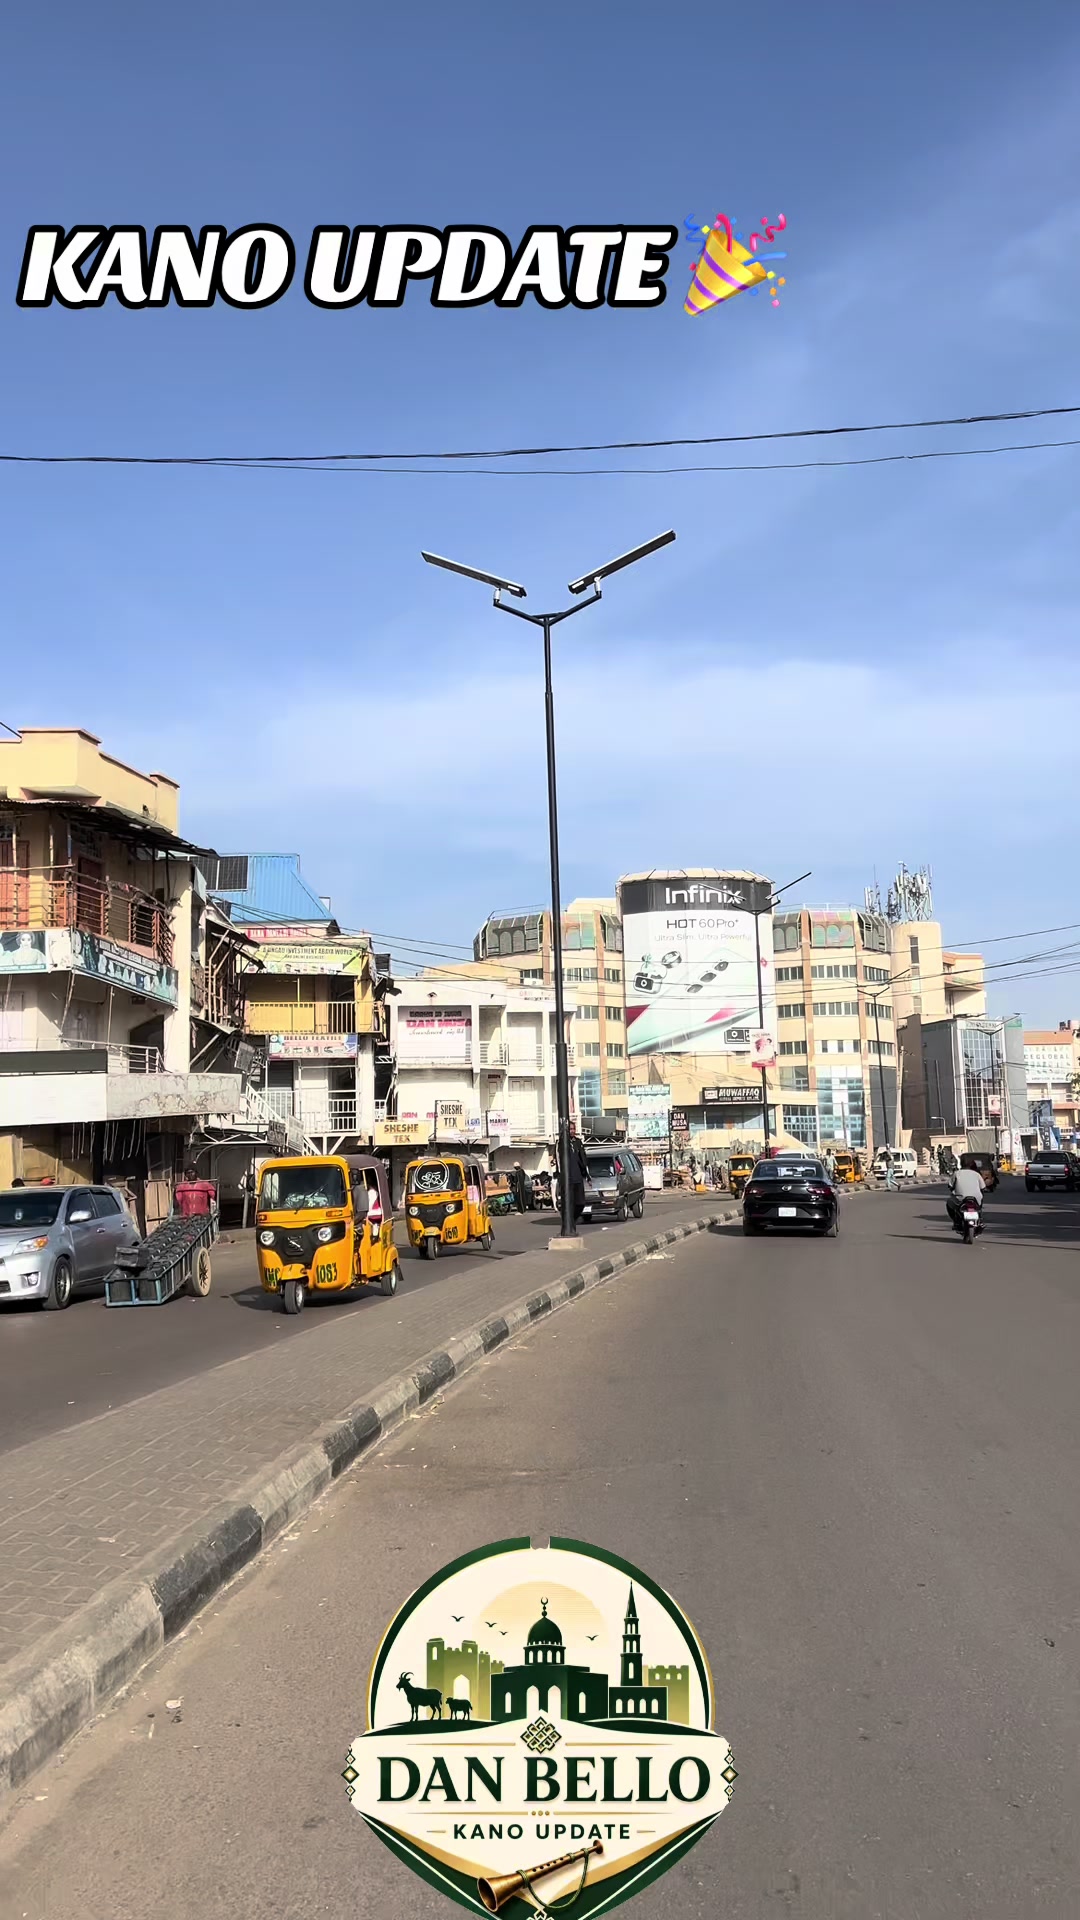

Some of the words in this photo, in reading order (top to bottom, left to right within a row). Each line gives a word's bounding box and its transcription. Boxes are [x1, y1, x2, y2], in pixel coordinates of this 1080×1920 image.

[665, 885, 742, 904] Infinix
[666, 919, 696, 929] HOT
[654, 933, 675, 941] Ultra
[698, 932, 719, 940] Ultra
[718, 1087, 760, 1097] MUWAFFAQ
[440, 1104, 463, 1115] SHESHE
[443, 1117, 458, 1128] TEX
[383, 1123, 419, 1133] SHESHE
[393, 1135, 412, 1143] TEX
